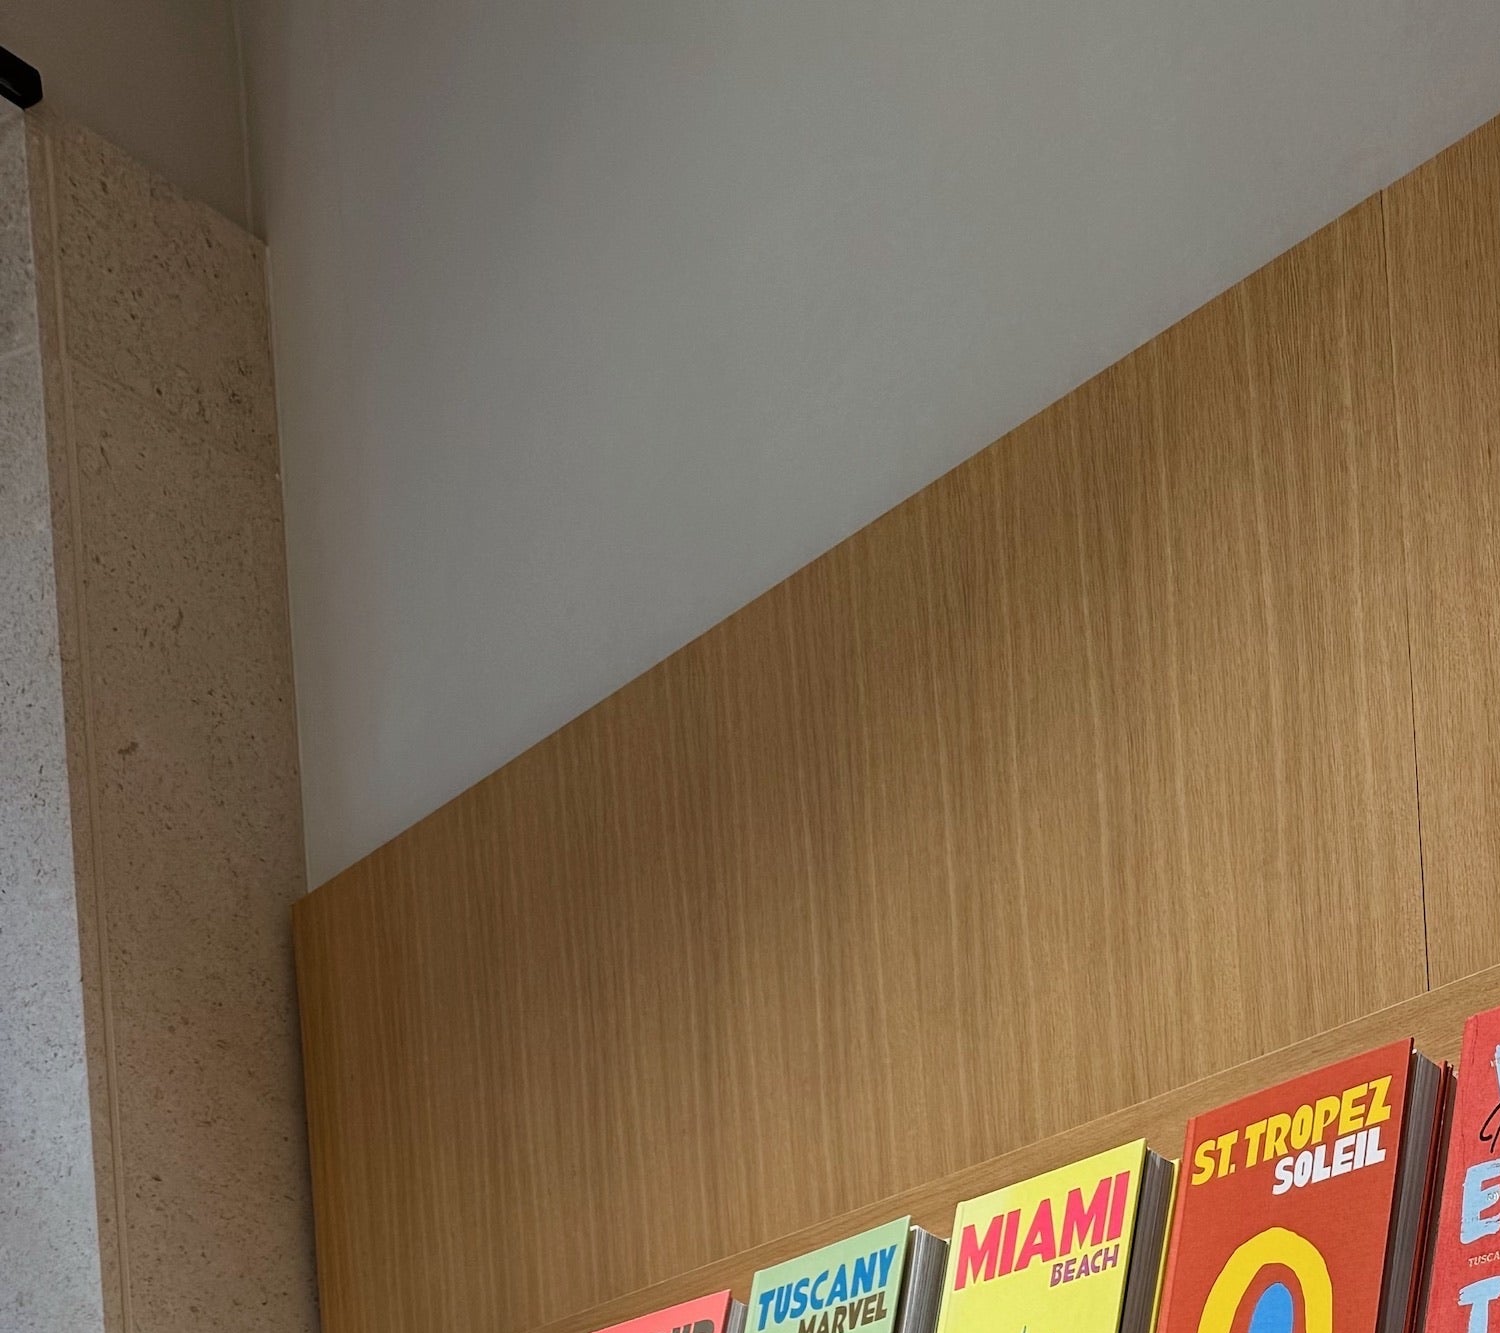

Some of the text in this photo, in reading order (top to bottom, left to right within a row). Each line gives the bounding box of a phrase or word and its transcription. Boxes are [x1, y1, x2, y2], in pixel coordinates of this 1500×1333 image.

[1191, 1075, 1393, 1186] ST. TROPEZ
[1272, 1126, 1387, 1195] SOLEIL
[954, 1171, 1131, 1291] MIAMI
[1050, 1244, 1120, 1288] BEACH
[757, 1245, 897, 1332] TUSCANY
